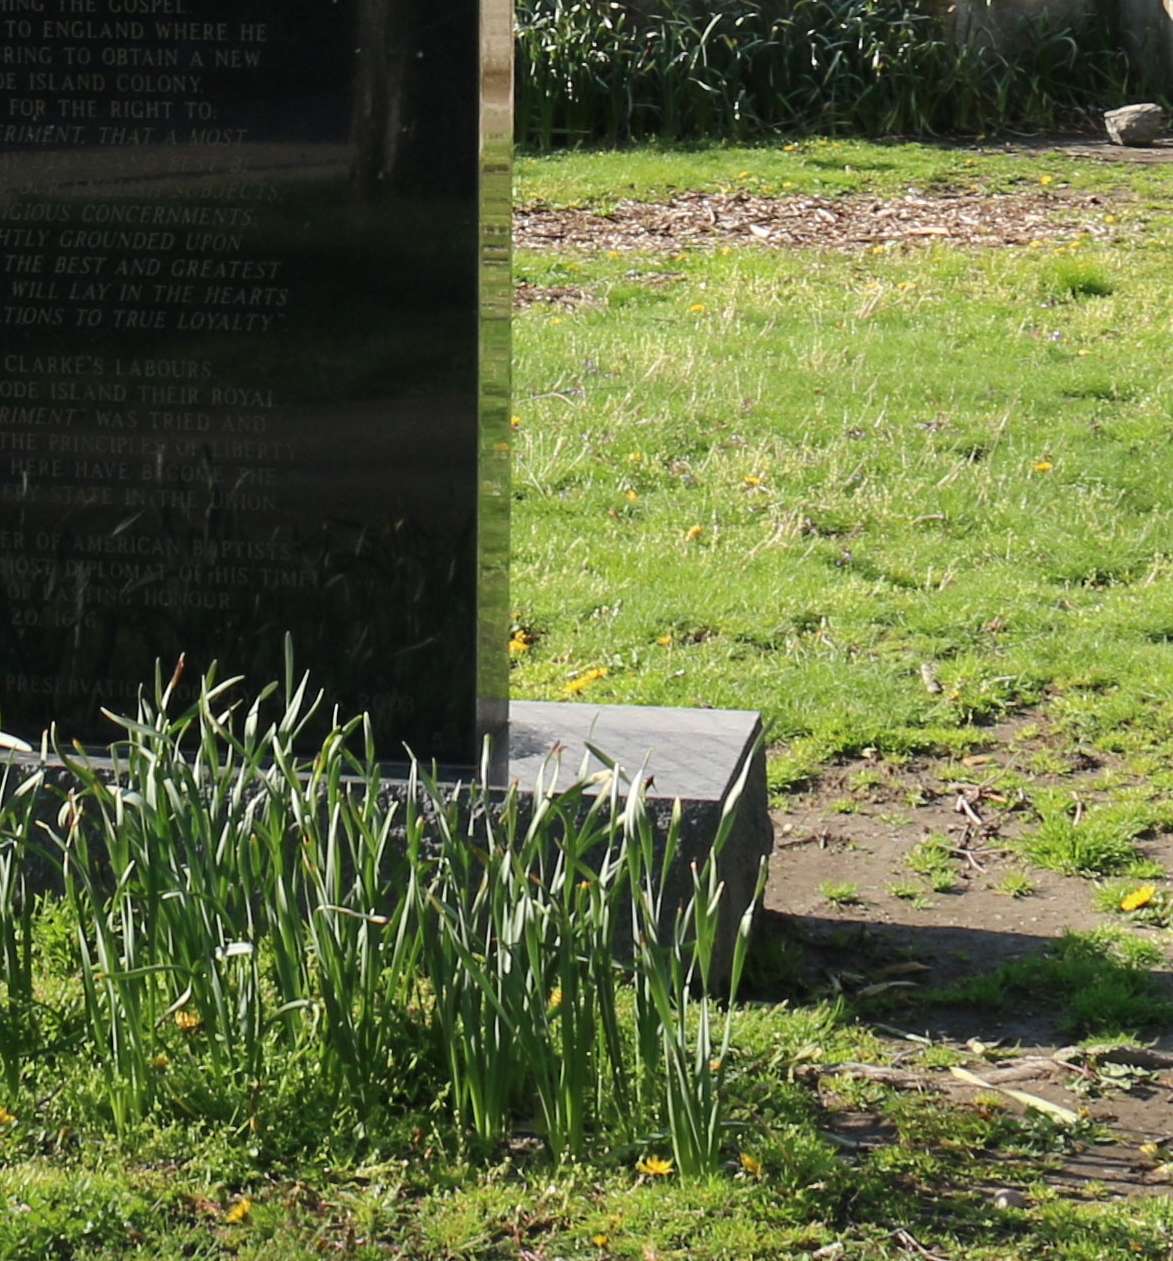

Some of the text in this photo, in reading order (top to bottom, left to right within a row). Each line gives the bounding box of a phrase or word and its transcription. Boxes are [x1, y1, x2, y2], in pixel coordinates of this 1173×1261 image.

[42, 20, 144, 40] ENGLAND
[154, 21, 227, 41] WHERE
[101, 47, 177, 66] OBTAIN
[29, 72, 105, 92] ISLAND
[110, 99, 173, 119] RIGHT
[96, 125, 159, 145] THAT
[185, 126, 248, 146] MOST
[57, 229, 176, 251] GROUNDED
[184, 232, 242, 252] UPON
[53, 255, 107, 275] BEST
[169, 258, 281, 280] GREATEST
[9, 280, 61, 300] WILL
[203, 285, 289, 306] HEARTS
[110, 308, 167, 328] TRUE
[4, 354, 104, 376] CLARKE'S
[50, 381, 126, 402] ISLAND
[137, 384, 198, 404] THEIR
[148, 411, 210, 432] TRIED
[10, 457, 62, 478] HERE
[74, 460, 129, 480] HAVE
